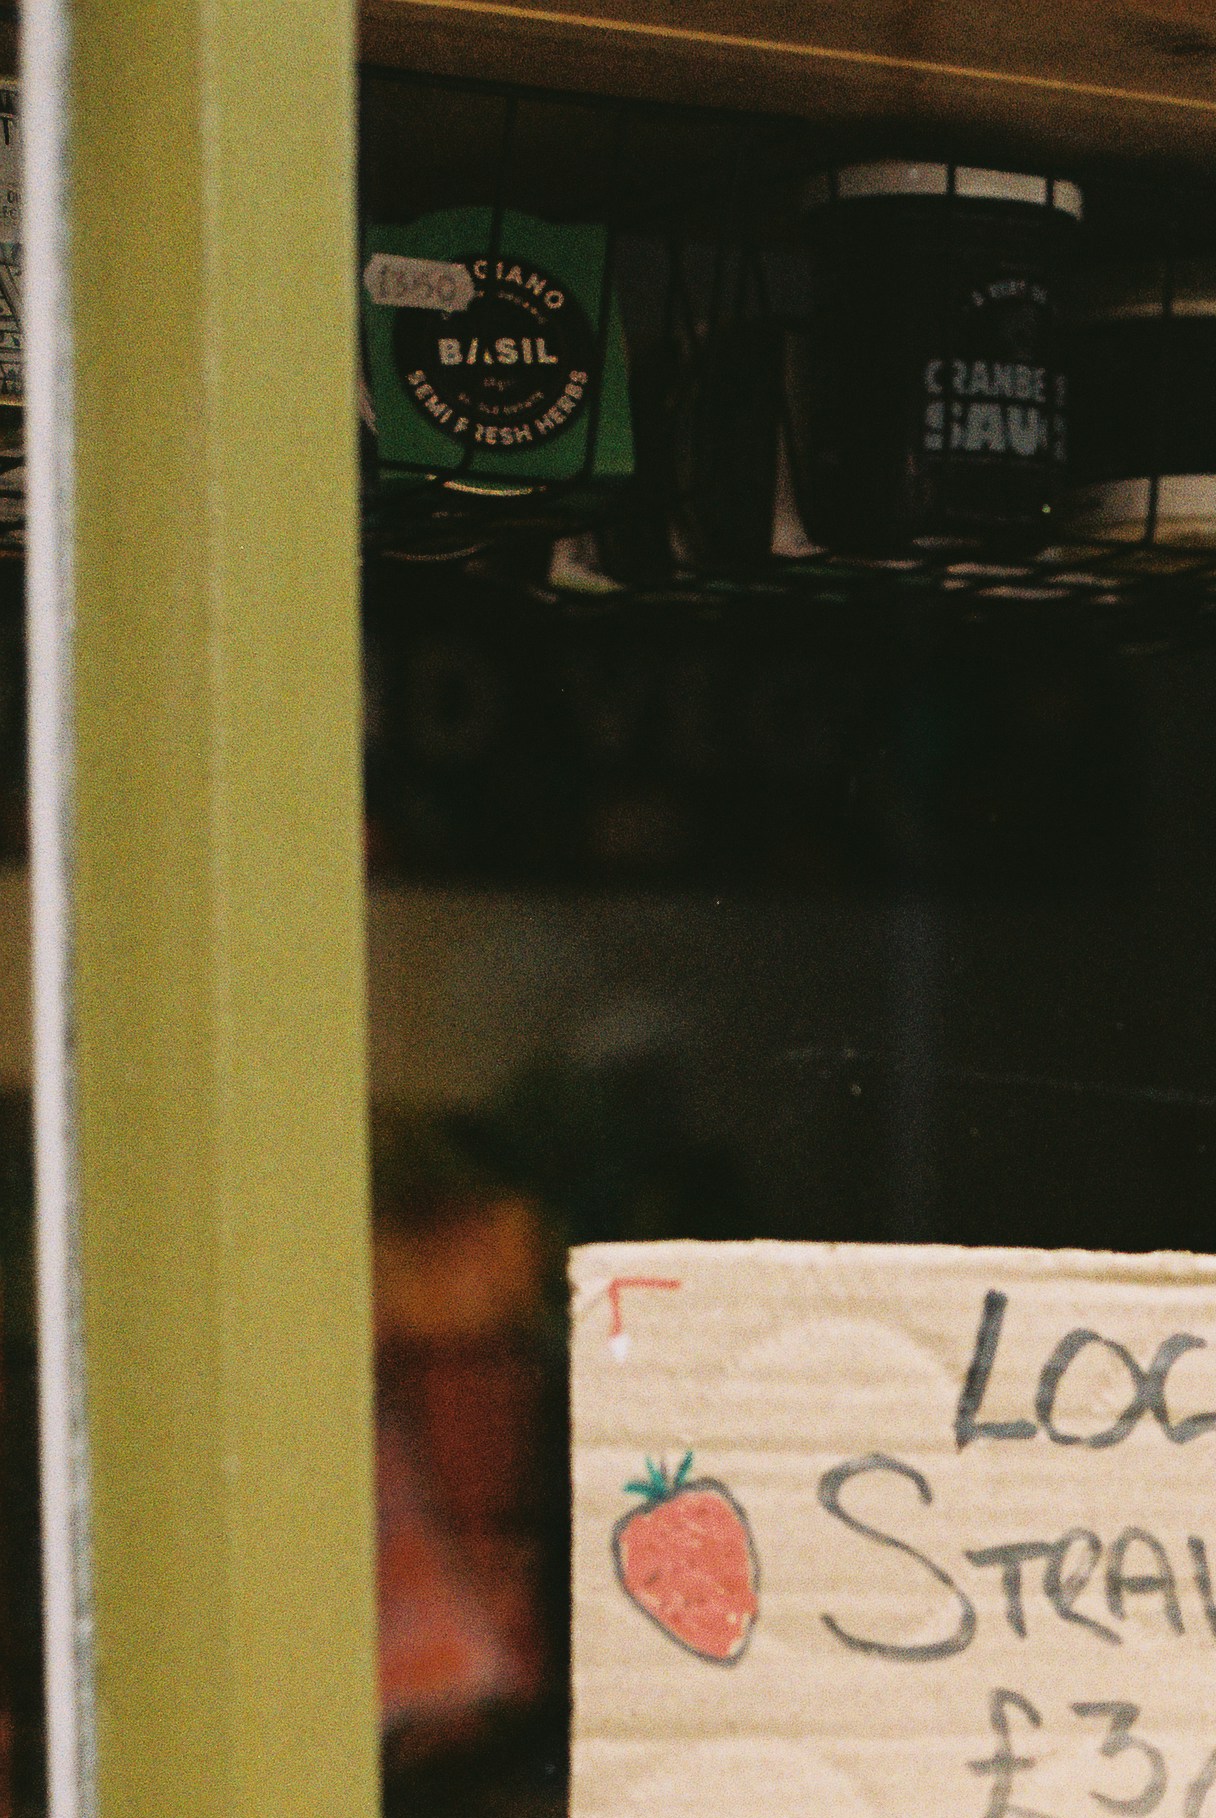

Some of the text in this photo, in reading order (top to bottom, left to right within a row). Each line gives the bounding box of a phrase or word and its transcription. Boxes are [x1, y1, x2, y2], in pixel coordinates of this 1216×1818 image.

[437, 336, 560, 366] BASIL
[406, 369, 455, 425] SEMI
[535, 369, 589, 435] HERBS
